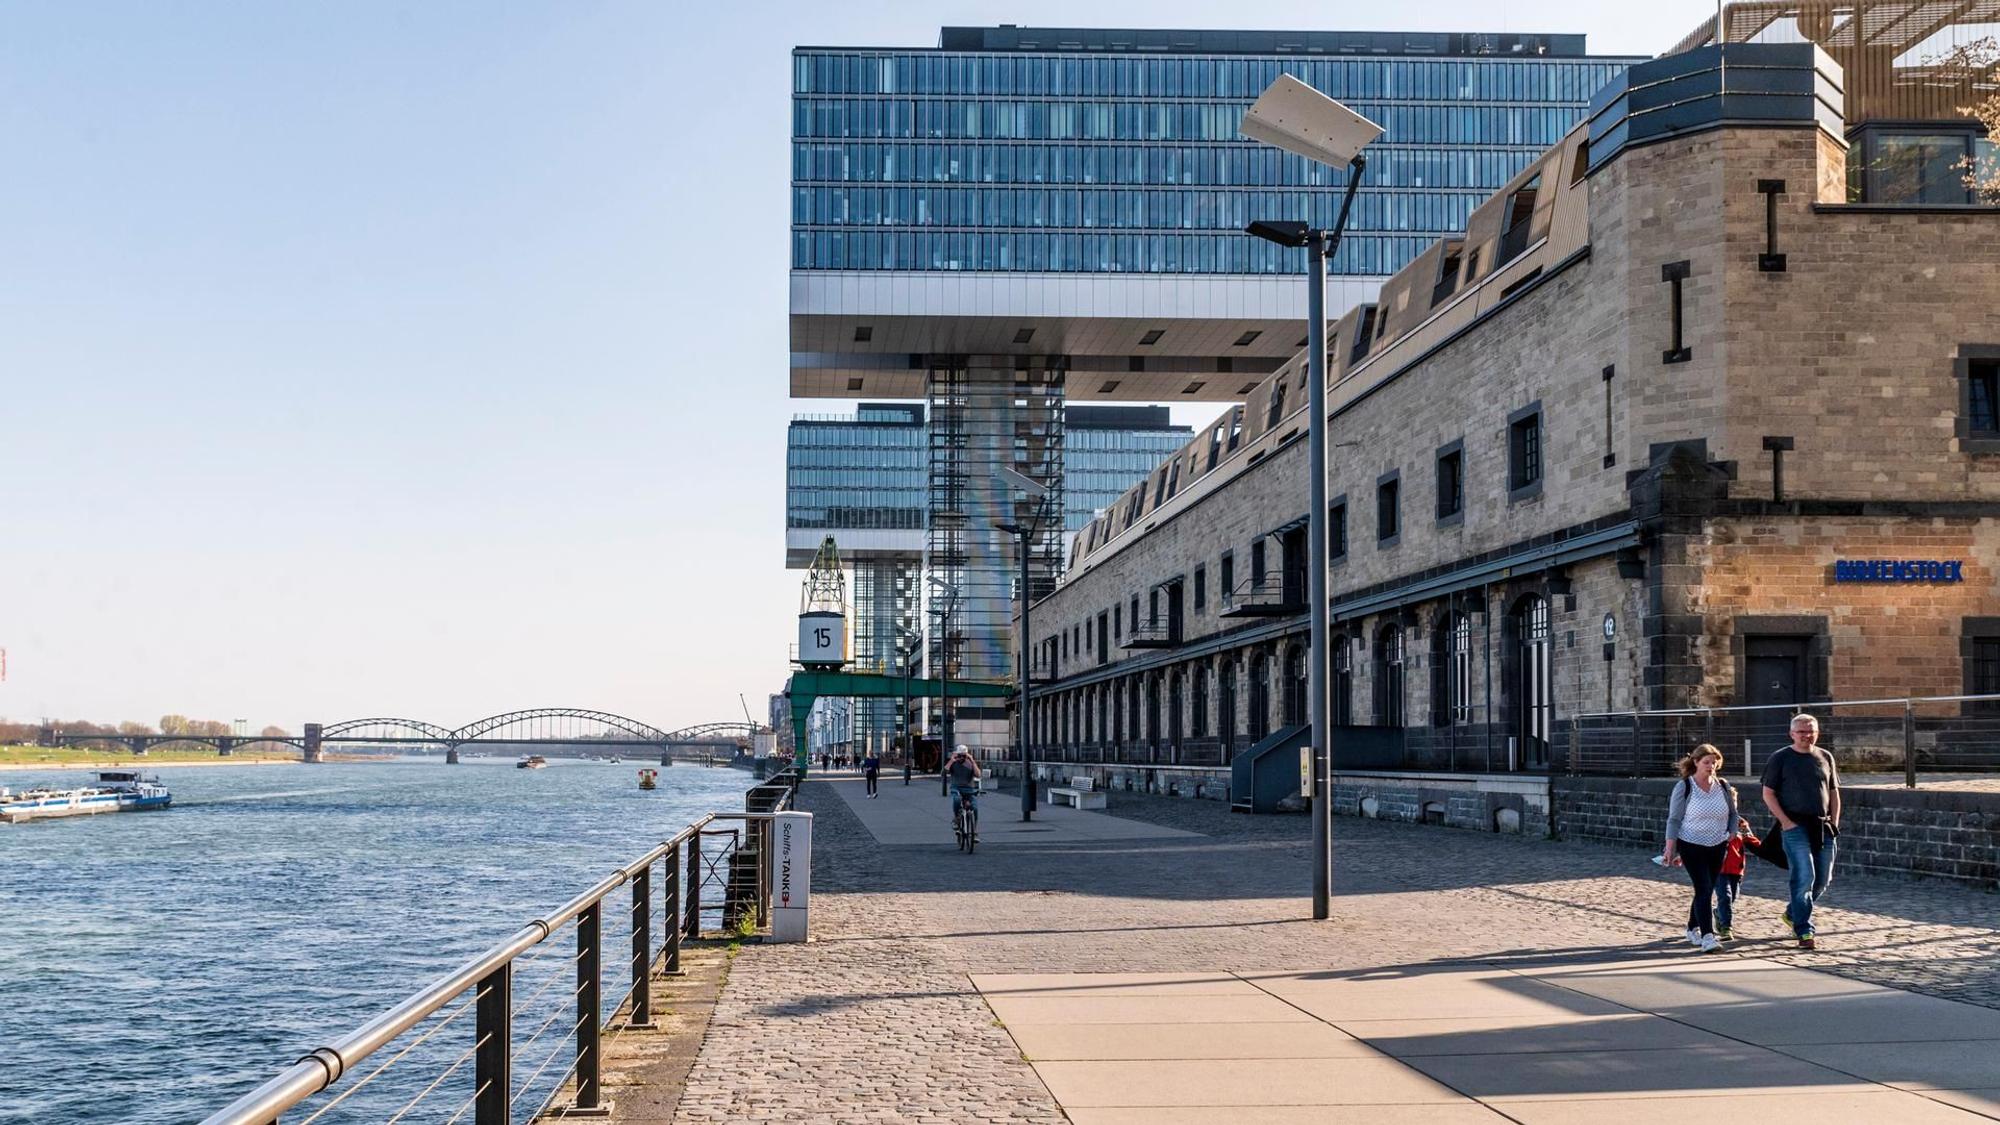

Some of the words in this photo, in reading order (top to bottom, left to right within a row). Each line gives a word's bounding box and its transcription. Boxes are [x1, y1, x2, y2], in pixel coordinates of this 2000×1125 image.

[1836, 560, 1963, 583] BIRKENSTOCK
[1605, 618, 1614, 635] 12
[814, 628, 831, 648] 15
